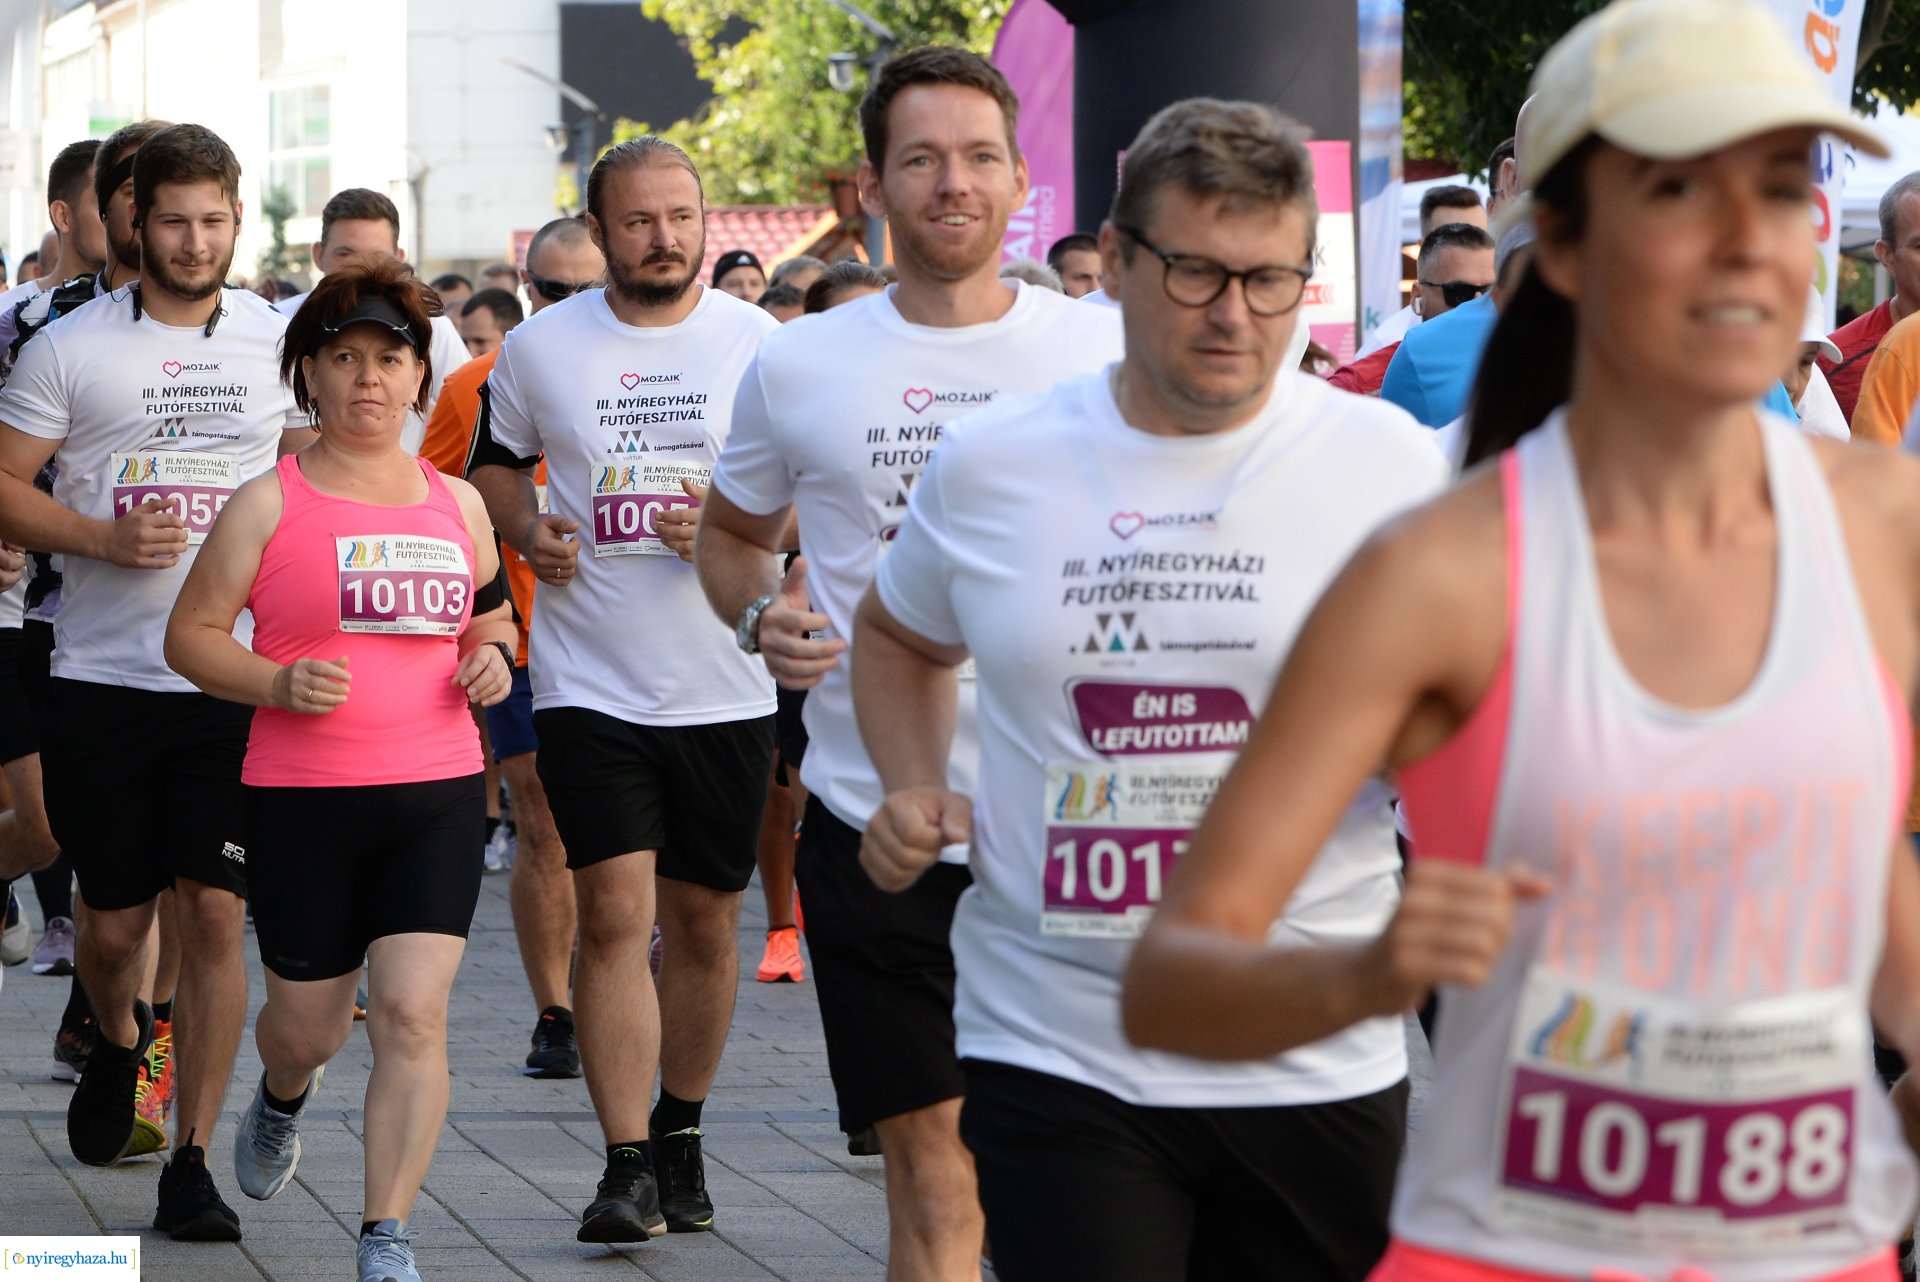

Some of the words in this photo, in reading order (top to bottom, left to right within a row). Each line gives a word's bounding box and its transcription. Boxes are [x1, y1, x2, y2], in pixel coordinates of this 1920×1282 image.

[641, 374, 680, 383] MOZAIK
[142, 388, 158, 399] III.
[162, 384, 248, 398] NYÍREGYHÁZI
[934, 392, 993, 403] MOZAIK
[146, 400, 245, 415] FUTÓFESZTIVÁL
[596, 400, 613, 410] III.
[617, 393, 707, 410] NYÍREGYHÁZI
[600, 409, 705, 427] FUTÓFESZTIVÁL
[192, 430, 241, 440] támogatásával
[866, 428, 890, 444] III.
[654, 441, 704, 452] támogatásával
[165, 465, 229, 477] FUTÓFESZTIVÁL
[643, 474, 709, 486] FUTÓFESTIVÁL
[598, 501, 689, 536] 100
[1062, 559, 1089, 578] III.
[1097, 548, 1265, 575] NYÍREGYHÁZI
[346, 578, 466, 616] 10103
[1062, 577, 1260, 607] FUTÓFESZTIVÁL
[1133, 690, 1167, 719] ÉN
[1171, 693, 1197, 717] IS
[1091, 720, 1250, 750] LEFUTOTTAM
[1551, 784, 1785, 894] KEEP
[1052, 838, 1190, 901] 101
[1518, 1091, 1848, 1206] 10188
